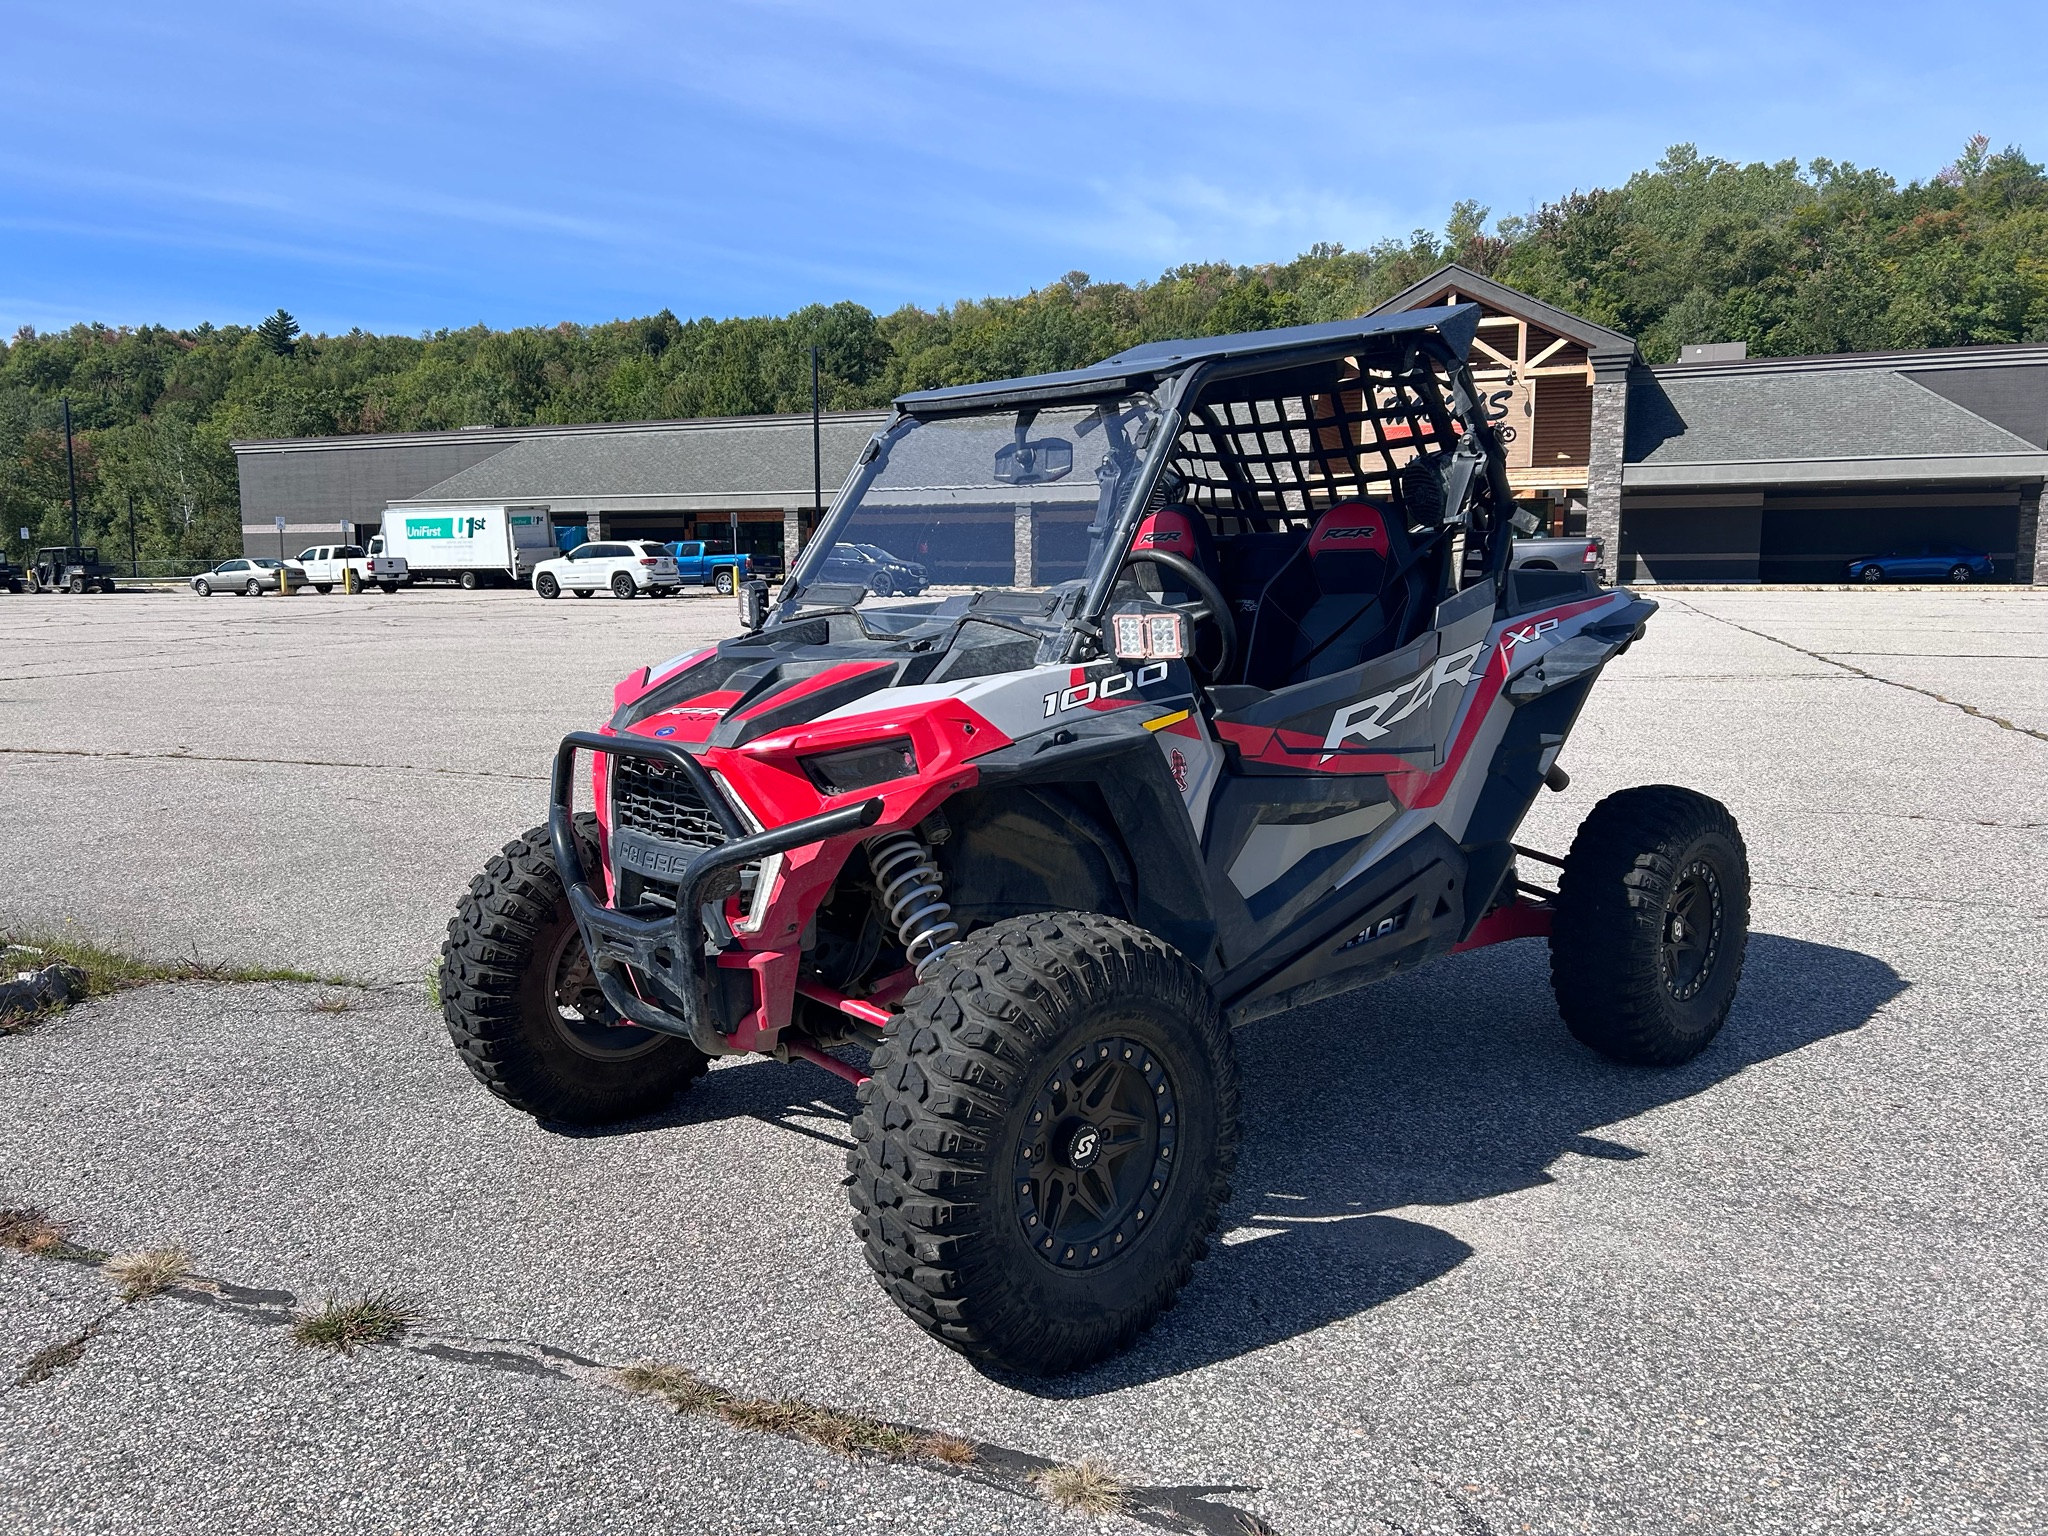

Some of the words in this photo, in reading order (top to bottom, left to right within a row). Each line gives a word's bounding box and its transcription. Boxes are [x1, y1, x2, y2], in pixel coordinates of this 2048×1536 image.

[407, 526, 441, 537] UniFirst
[1139, 531, 1183, 545] RZR
[1320, 526, 1377, 541] RZR
[1505, 617, 1559, 651] XP
[1043, 660, 1168, 719] 1000
[1319, 640, 1490, 766] RZR
[620, 842, 688, 875] POLARIS
